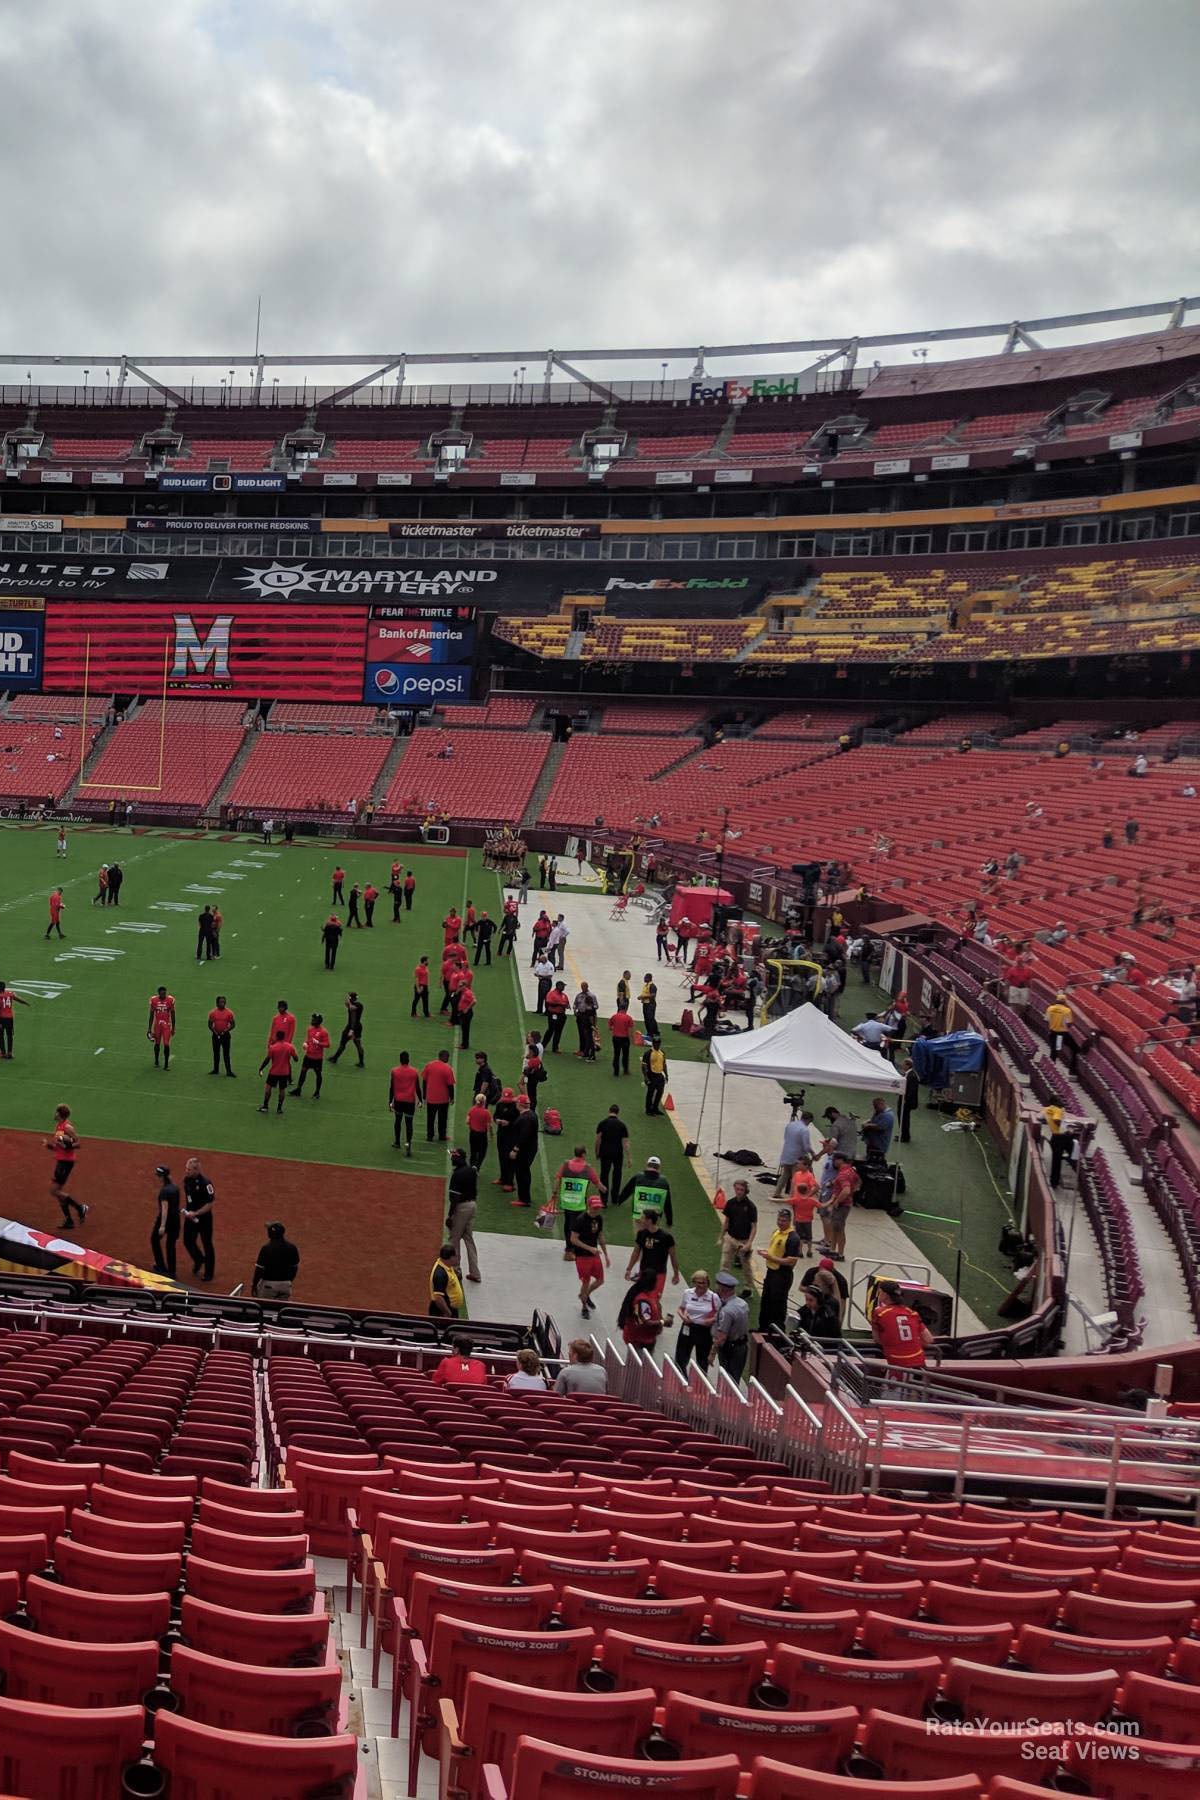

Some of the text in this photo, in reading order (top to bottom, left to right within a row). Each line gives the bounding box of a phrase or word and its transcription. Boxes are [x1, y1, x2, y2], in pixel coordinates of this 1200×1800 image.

[690, 378, 798, 400] FedExField
[163, 478, 207, 487] BUD LIGHT
[237, 479, 281, 487] BUD LIGHT
[166, 521, 193, 529] PROUD
[194, 521, 204, 529] TO
[205, 521, 237, 530] DELIVER
[238, 521, 253, 530] FOR
[254, 522, 269, 530] THE
[269, 522, 310, 530] REDSKINS.
[400, 524, 477, 537] ticketmaster
[505, 524, 585, 538] ticketmaster
[324, 569, 498, 583] MARYLAND
[57, 578, 78, 588] to
[82, 578, 107, 590] fly
[606, 577, 749, 591] FedExField
[379, 628, 463, 640] Bank of America
[169, 613, 236, 679] M
[403, 675, 463, 696] pepsi
[62, 946, 126, 962] 30
[2, 996, 12, 1009] 14
[896, 1315, 912, 1341] 6
[420, 1553, 459, 1564] STOMPING
[598, 1603, 642, 1615] STOMPING
[477, 1635, 559, 1650] STOMPING ZONE!
[908, 1631, 954, 1642] STOMPING
[718, 1716, 777, 1733] STOMPING
[574, 1766, 641, 1786] STOMPING
